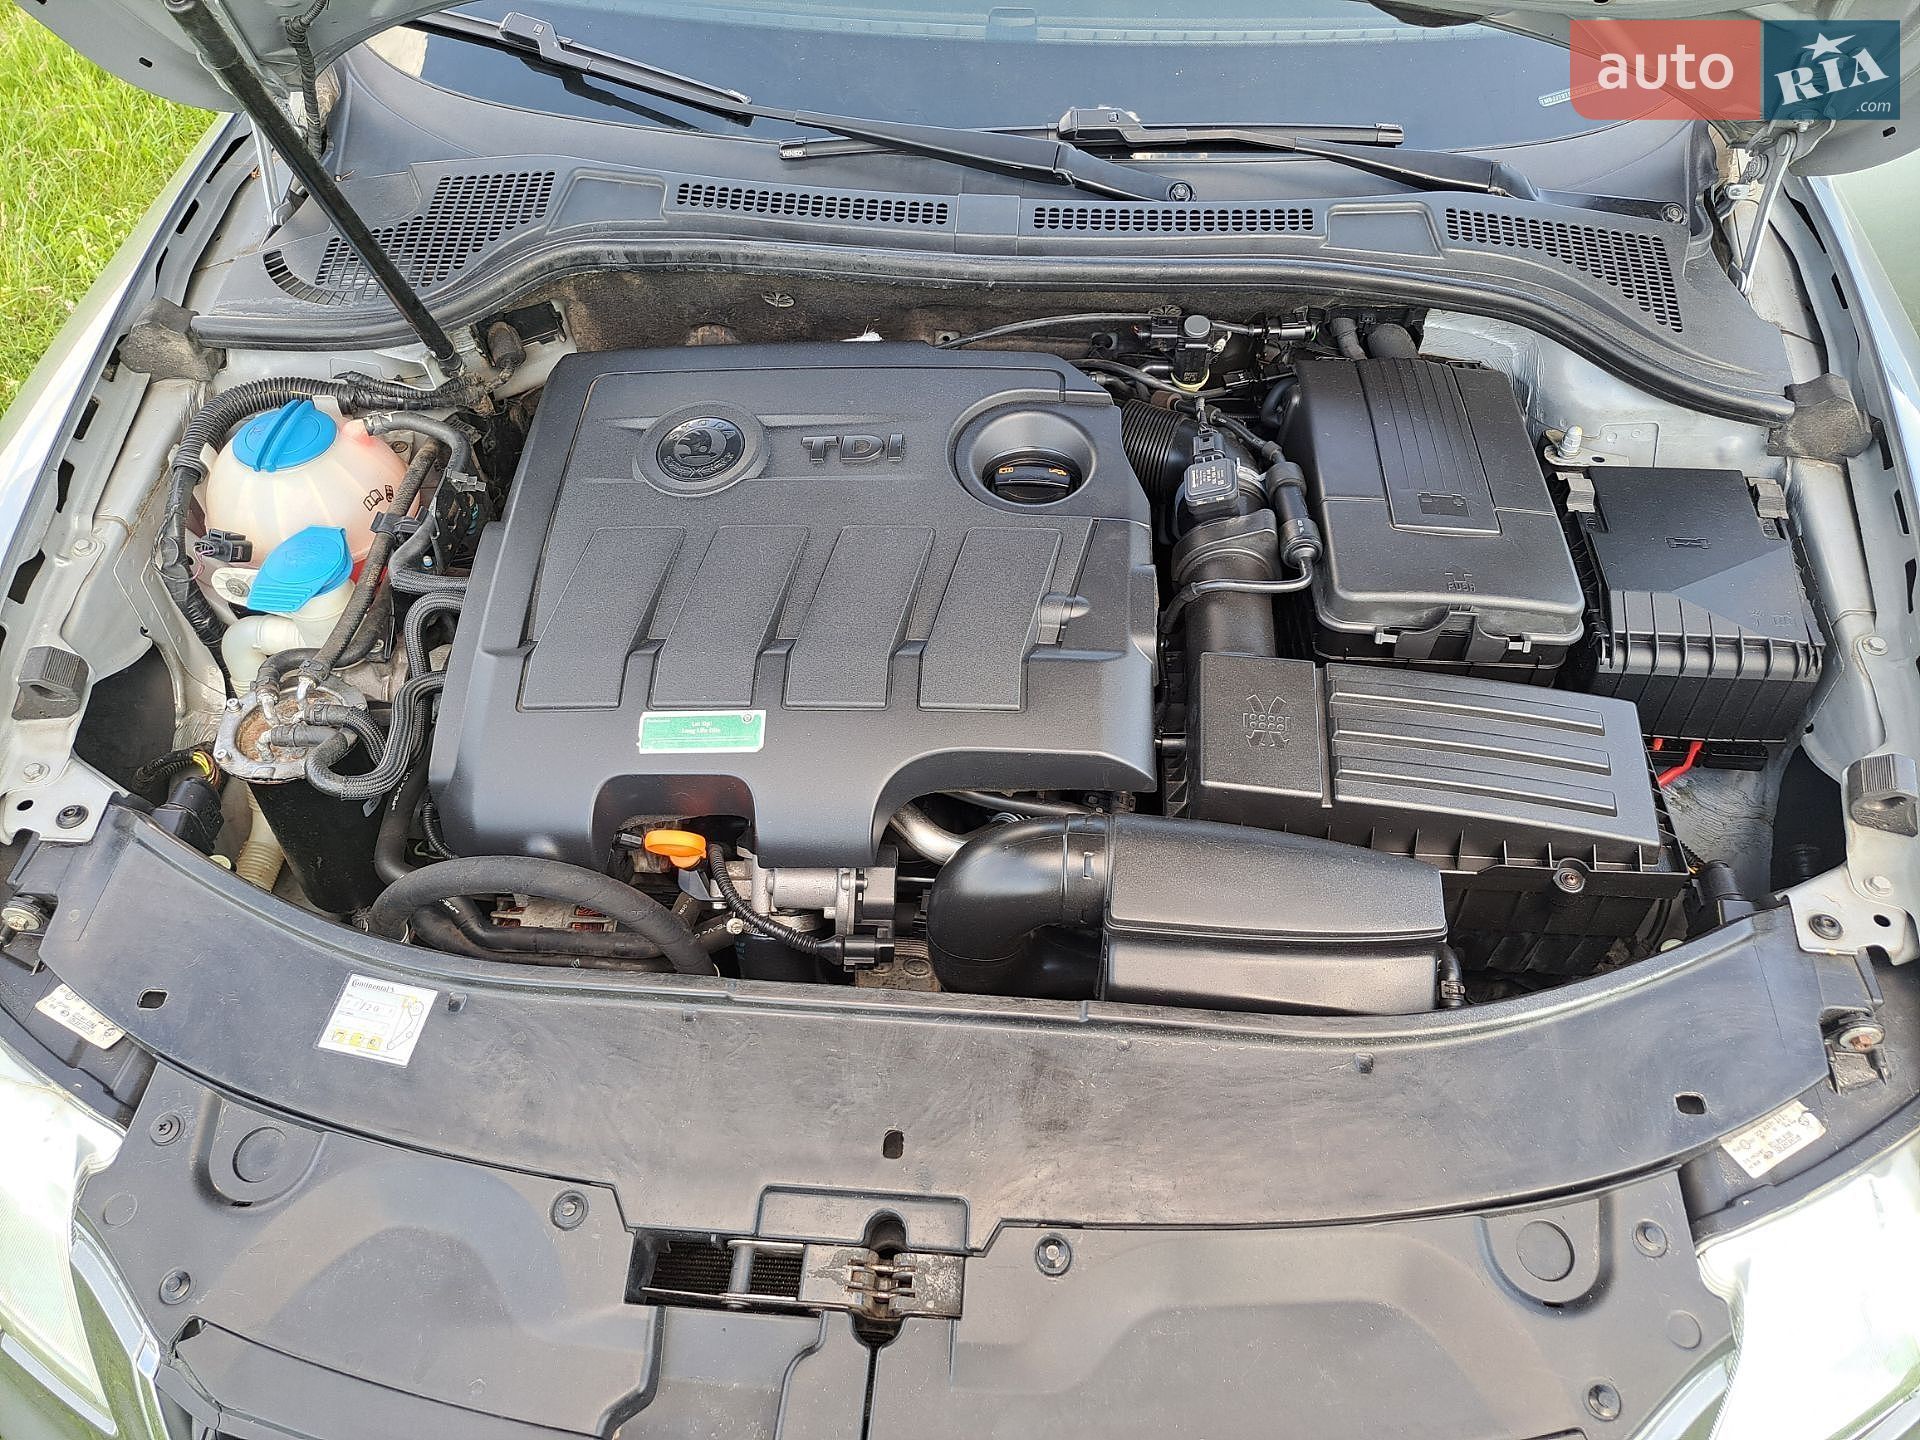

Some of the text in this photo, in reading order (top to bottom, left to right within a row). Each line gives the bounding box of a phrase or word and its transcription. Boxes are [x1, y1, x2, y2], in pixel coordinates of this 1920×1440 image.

[801, 433, 903, 462] TDI
[1447, 581, 1476, 592] PUSH
[351, 979, 390, 993] Continental
